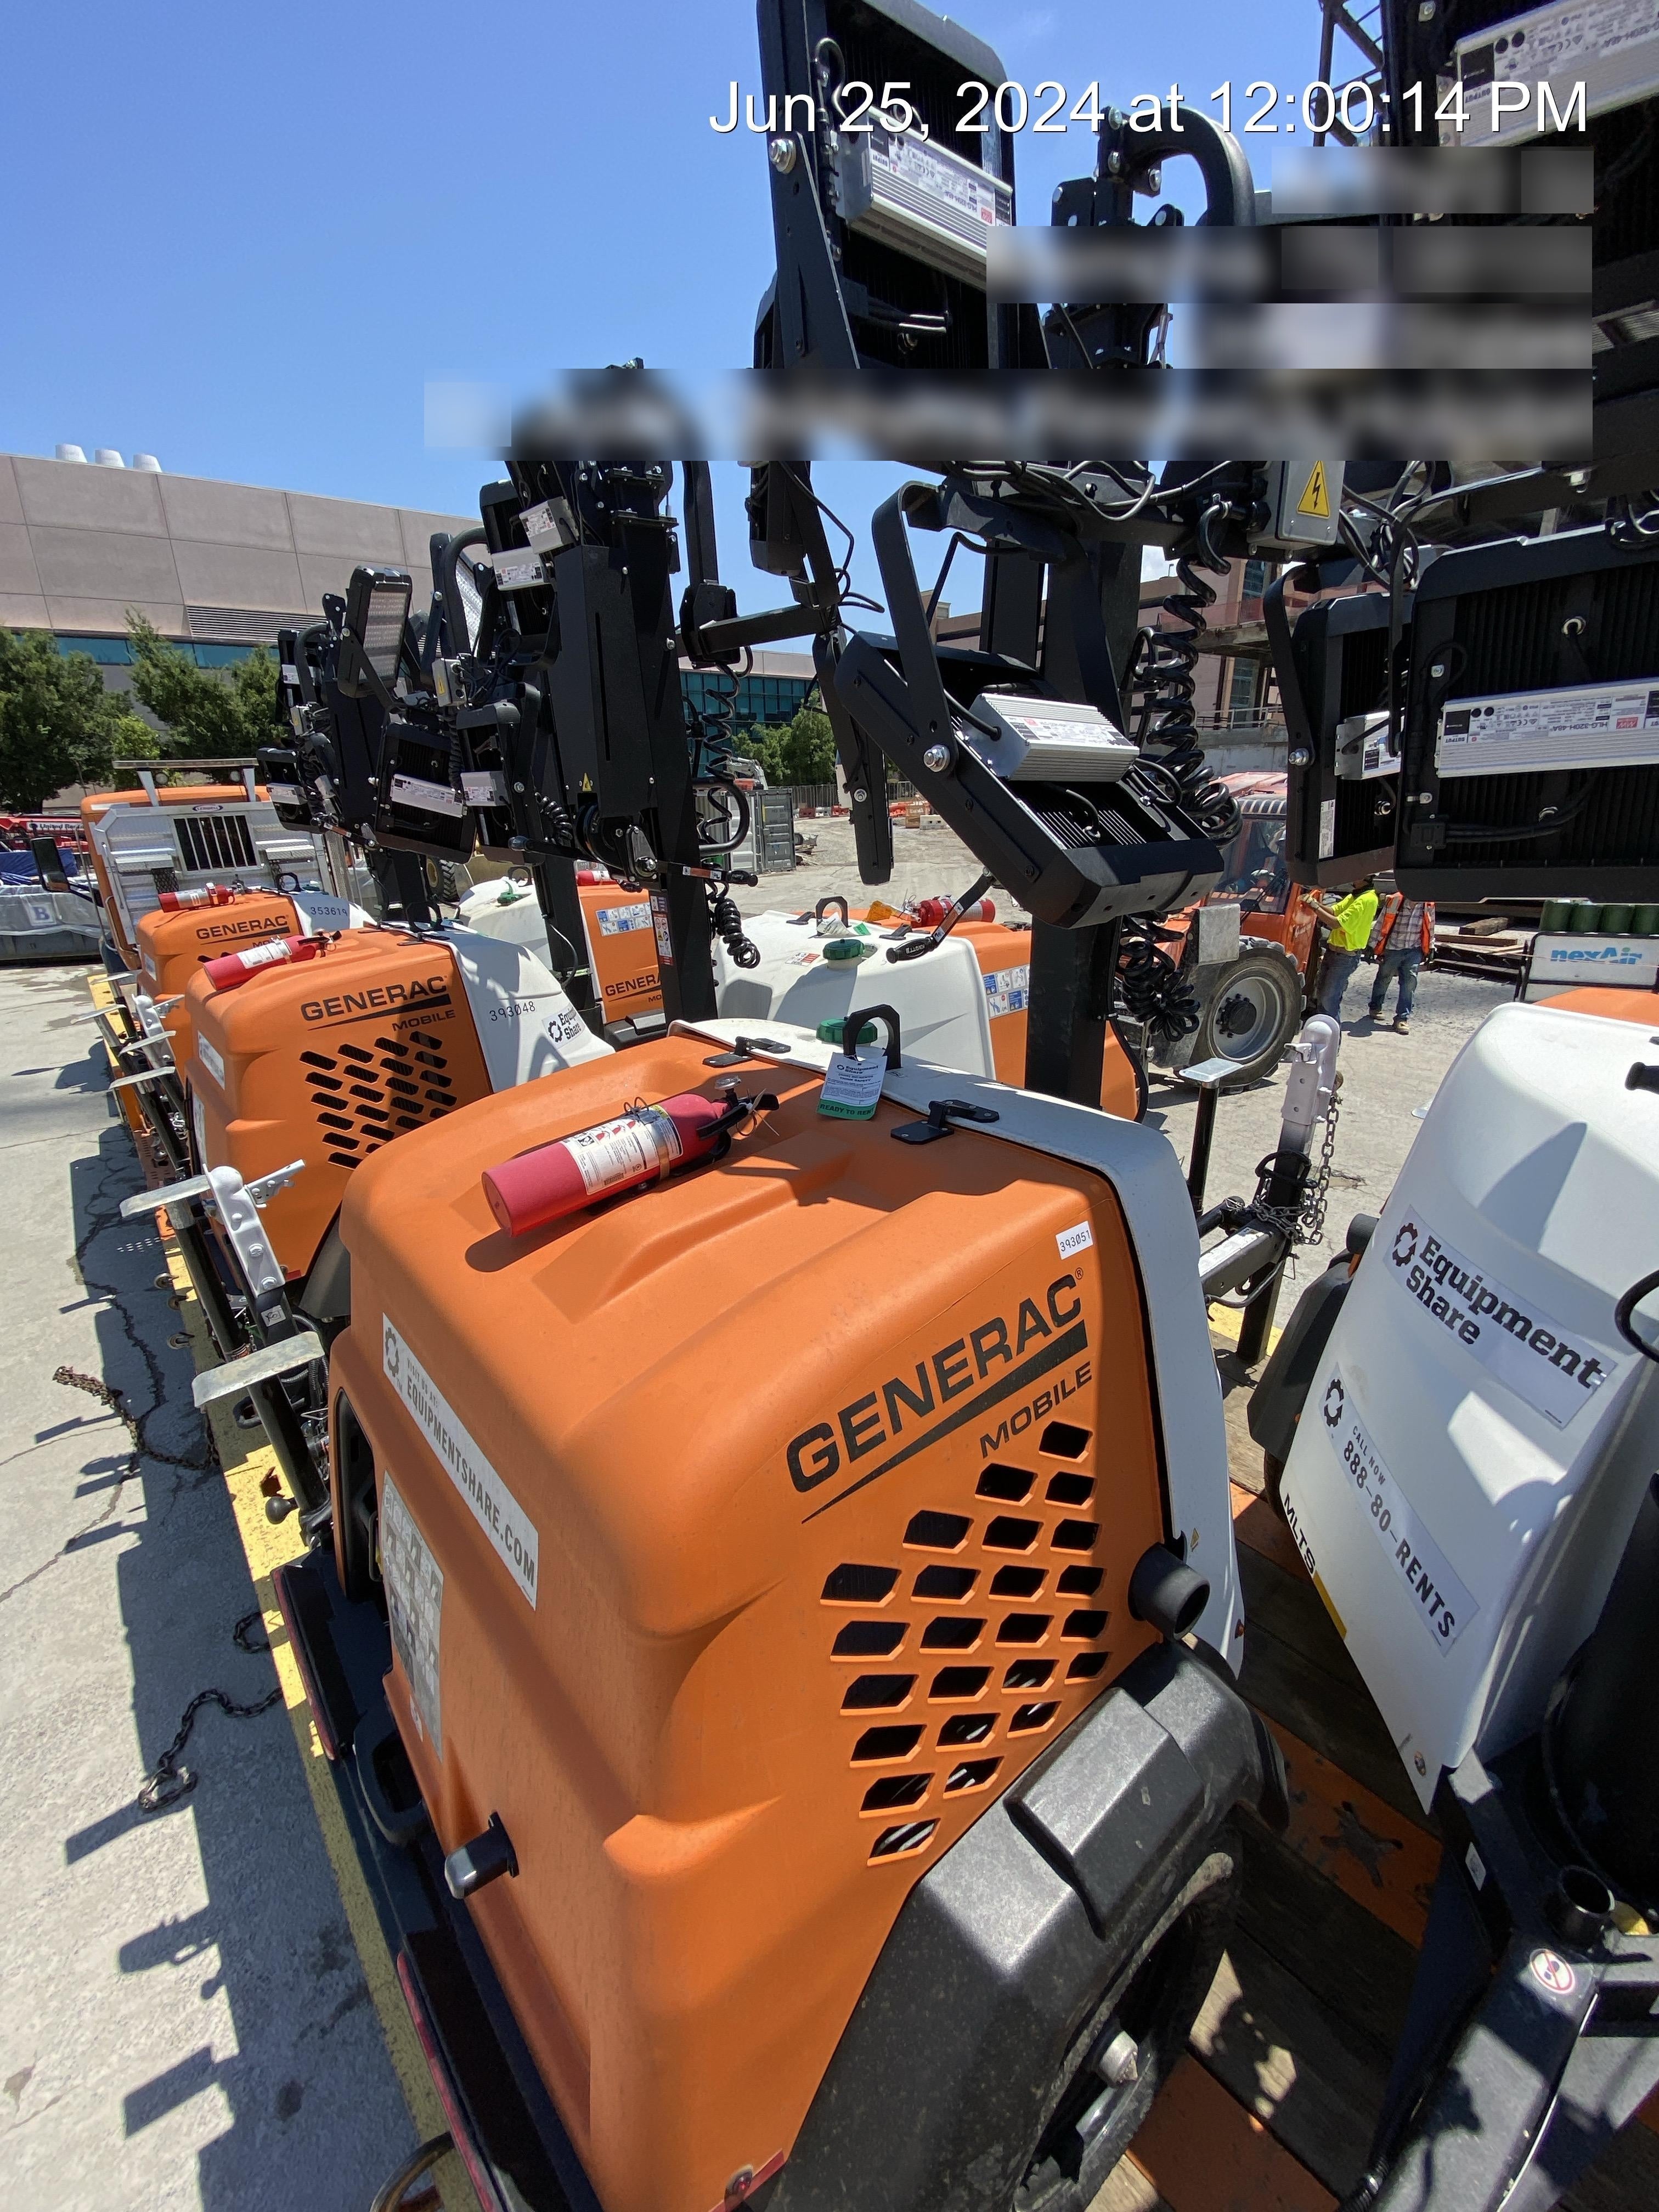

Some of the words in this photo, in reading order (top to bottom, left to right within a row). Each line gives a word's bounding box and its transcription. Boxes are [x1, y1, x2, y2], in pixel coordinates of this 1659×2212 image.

[34, 906, 50, 920] B
[196, 916, 288, 939] GENERAC
[311, 906, 348, 916] 353619
[1550, 947, 1642, 964] nexAir
[301, 976, 447, 1021] GENERAC
[489, 1001, 535, 1021] 393048
[392, 1009, 455, 1031] MOBILE
[820, 1104, 844, 1113] READY
[1059, 1229, 1091, 1252] 393051
[1406, 1265, 1480, 1345] Share
[1419, 1235, 1606, 1389] Equipment
[786, 1273, 1082, 1492] GENERAC
[979, 1361, 1092, 1459] MOBILE
[1353, 1425, 1367, 1457] CALL
[1368, 1456, 1386, 1486] NOW
[407, 1374, 535, 1587] EQUIPMENTSHARE.COM
[1284, 1493, 1316, 1575] MLTS
